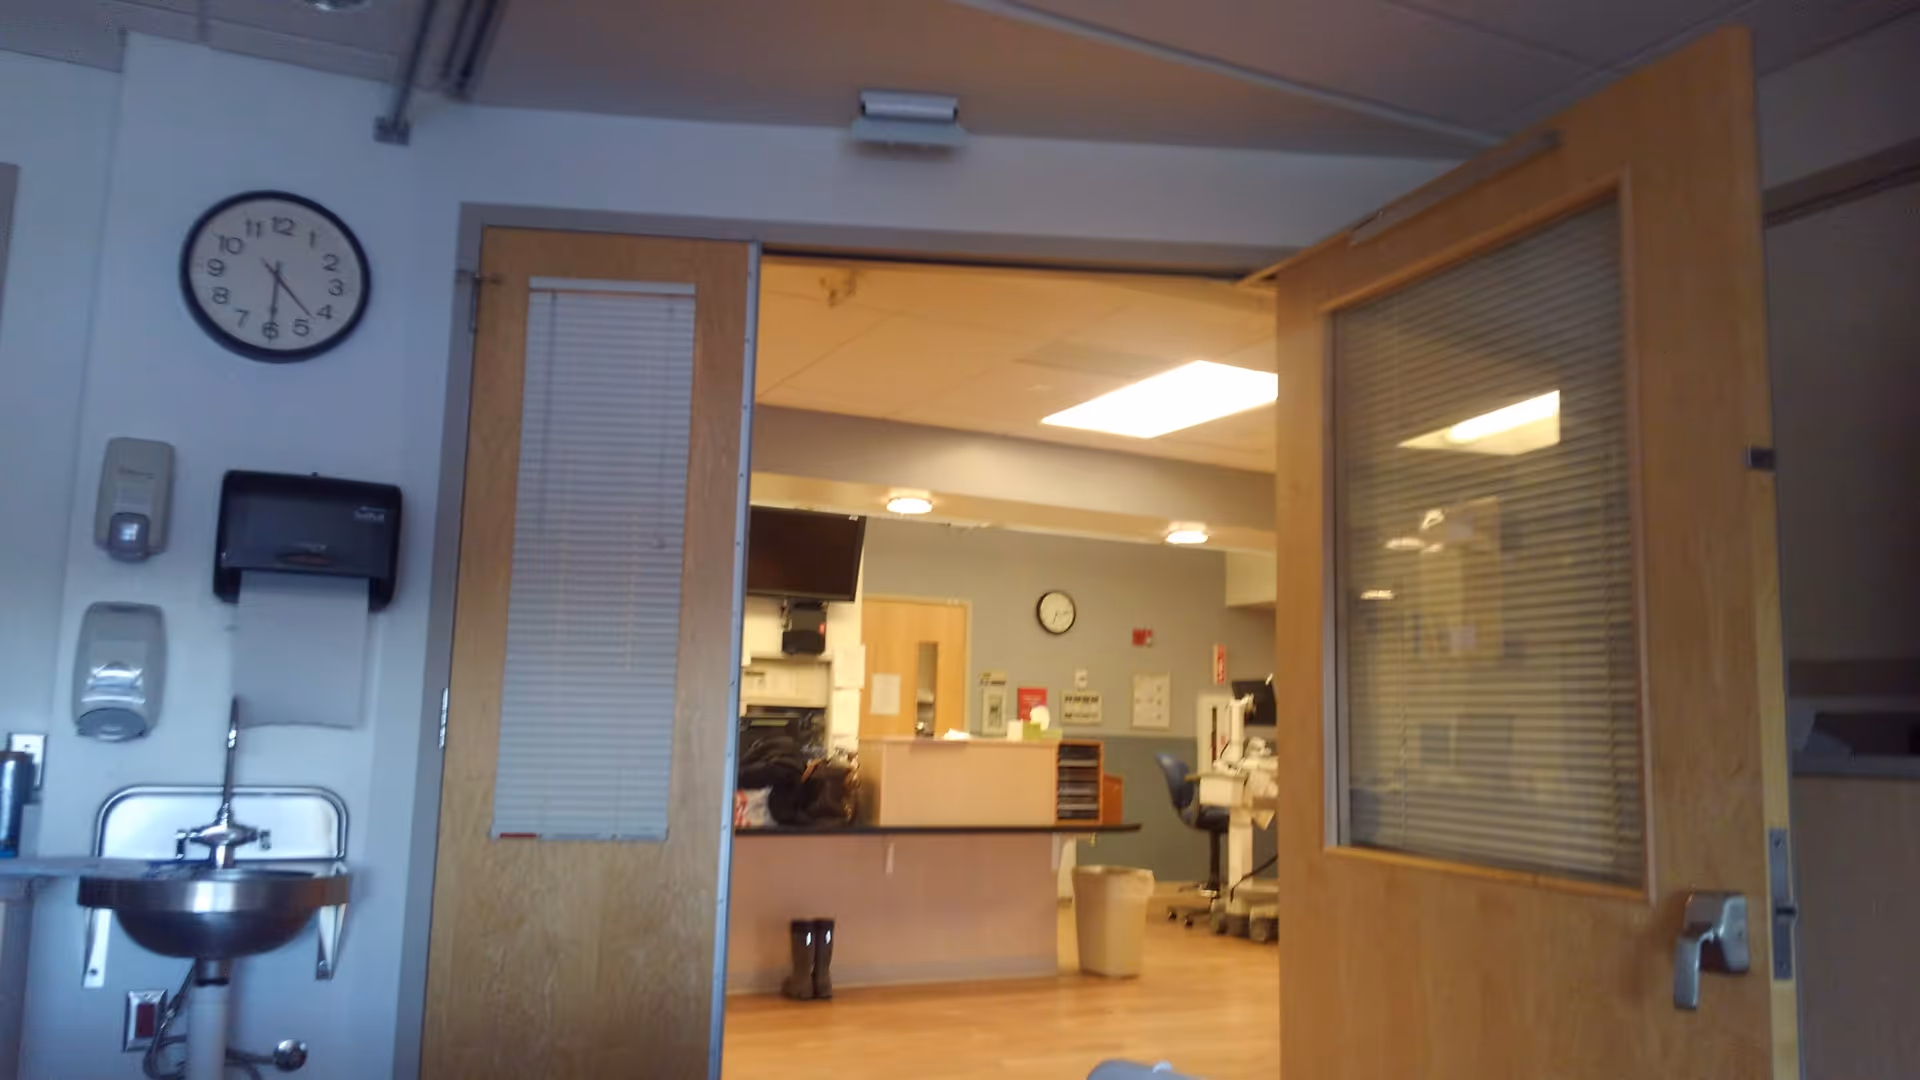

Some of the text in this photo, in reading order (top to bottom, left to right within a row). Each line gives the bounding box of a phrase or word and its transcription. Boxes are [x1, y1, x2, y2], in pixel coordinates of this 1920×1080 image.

[246, 219, 262, 238] 11
[271, 216, 296, 236] 12
[219, 235, 243, 255] 10
[308, 230, 316, 248] 1
[207, 258, 225, 277] 9
[323, 254, 340, 272] 2
[212, 286, 229, 304] 8
[328, 278, 344, 297] 3
[235, 308, 249, 328] 7
[316, 304, 333, 320] 4
[261, 321, 279, 340] 6
[292, 318, 310, 337] 5
